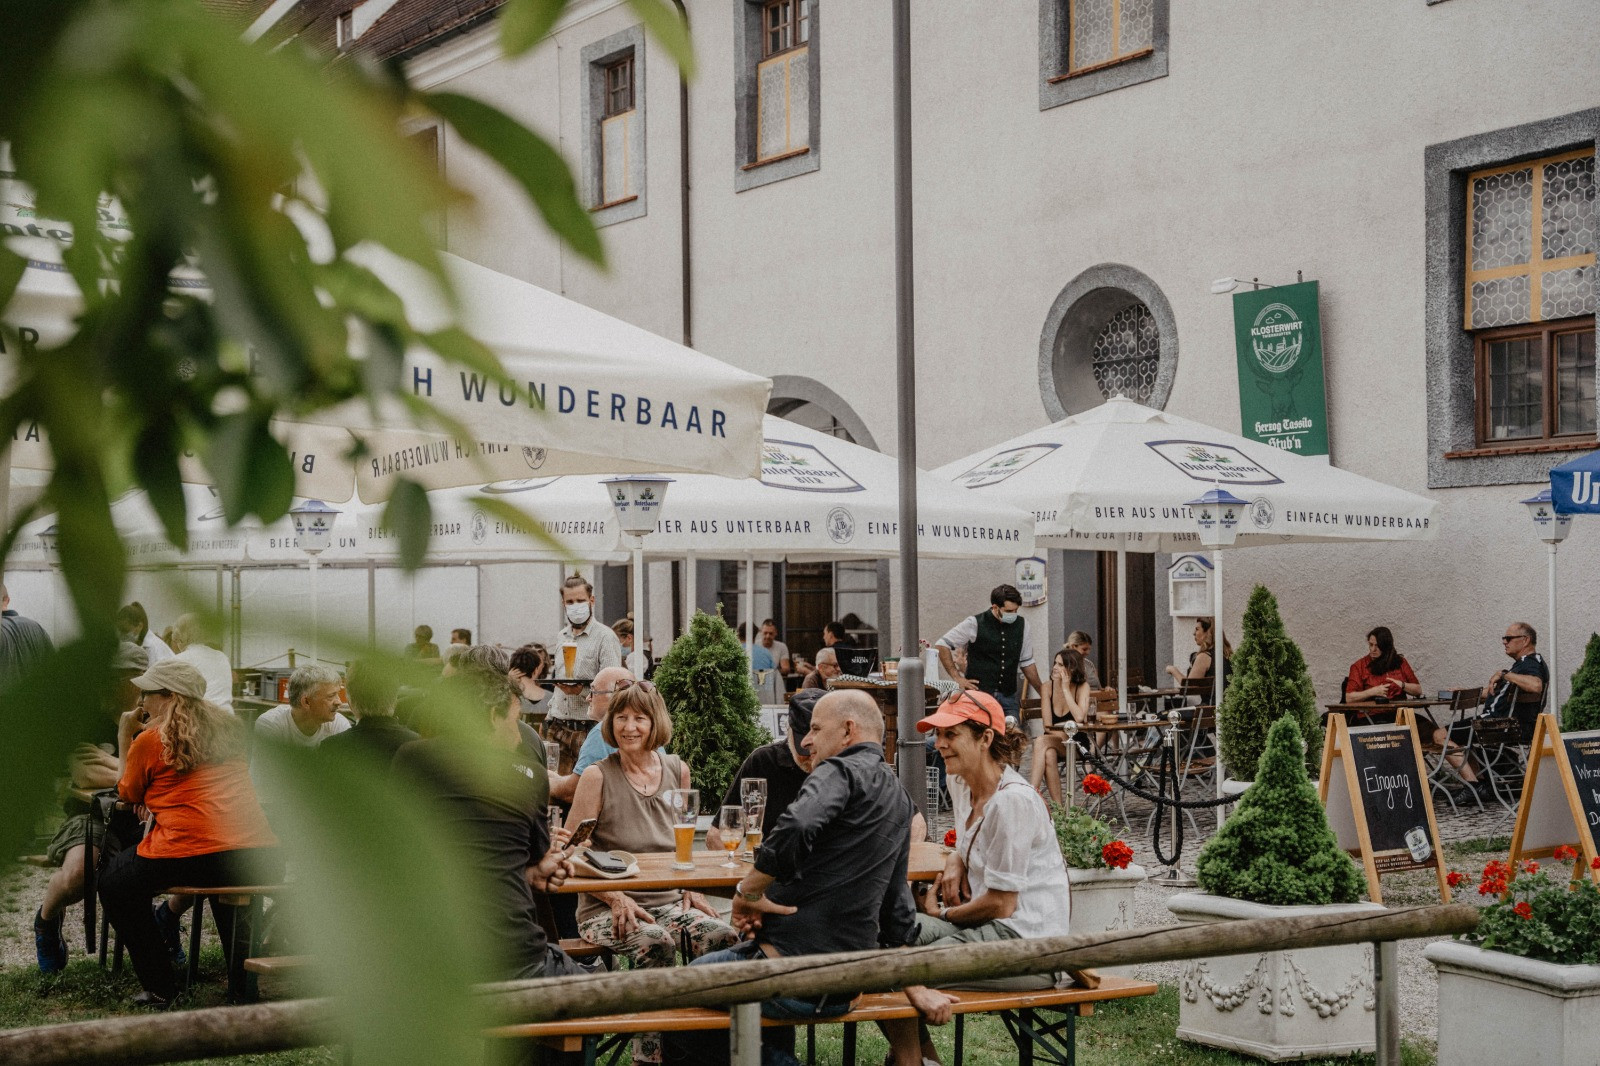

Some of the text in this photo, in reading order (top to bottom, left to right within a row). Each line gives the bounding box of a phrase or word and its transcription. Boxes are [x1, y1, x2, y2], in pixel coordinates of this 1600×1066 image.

[1251, 321, 1302, 336] KLOSTERWIRT
[460, 371, 726, 438] WUNDERBAAR
[1255, 417, 1312, 434] Herzog Tassilo
[762, 466, 840, 477] nterbaarer
[1095, 506, 1125, 518] BIER
[1132, 507, 1156, 519] AUS
[1286, 505, 1430, 529] EINFACH WUNDERBAAR
[653, 520, 811, 533] IER AUS UNTERBAAR
[868, 521, 925, 536] EINFH
[932, 524, 1020, 542] WUNDERBAAR
[1364, 766, 1413, 809] Eingang
